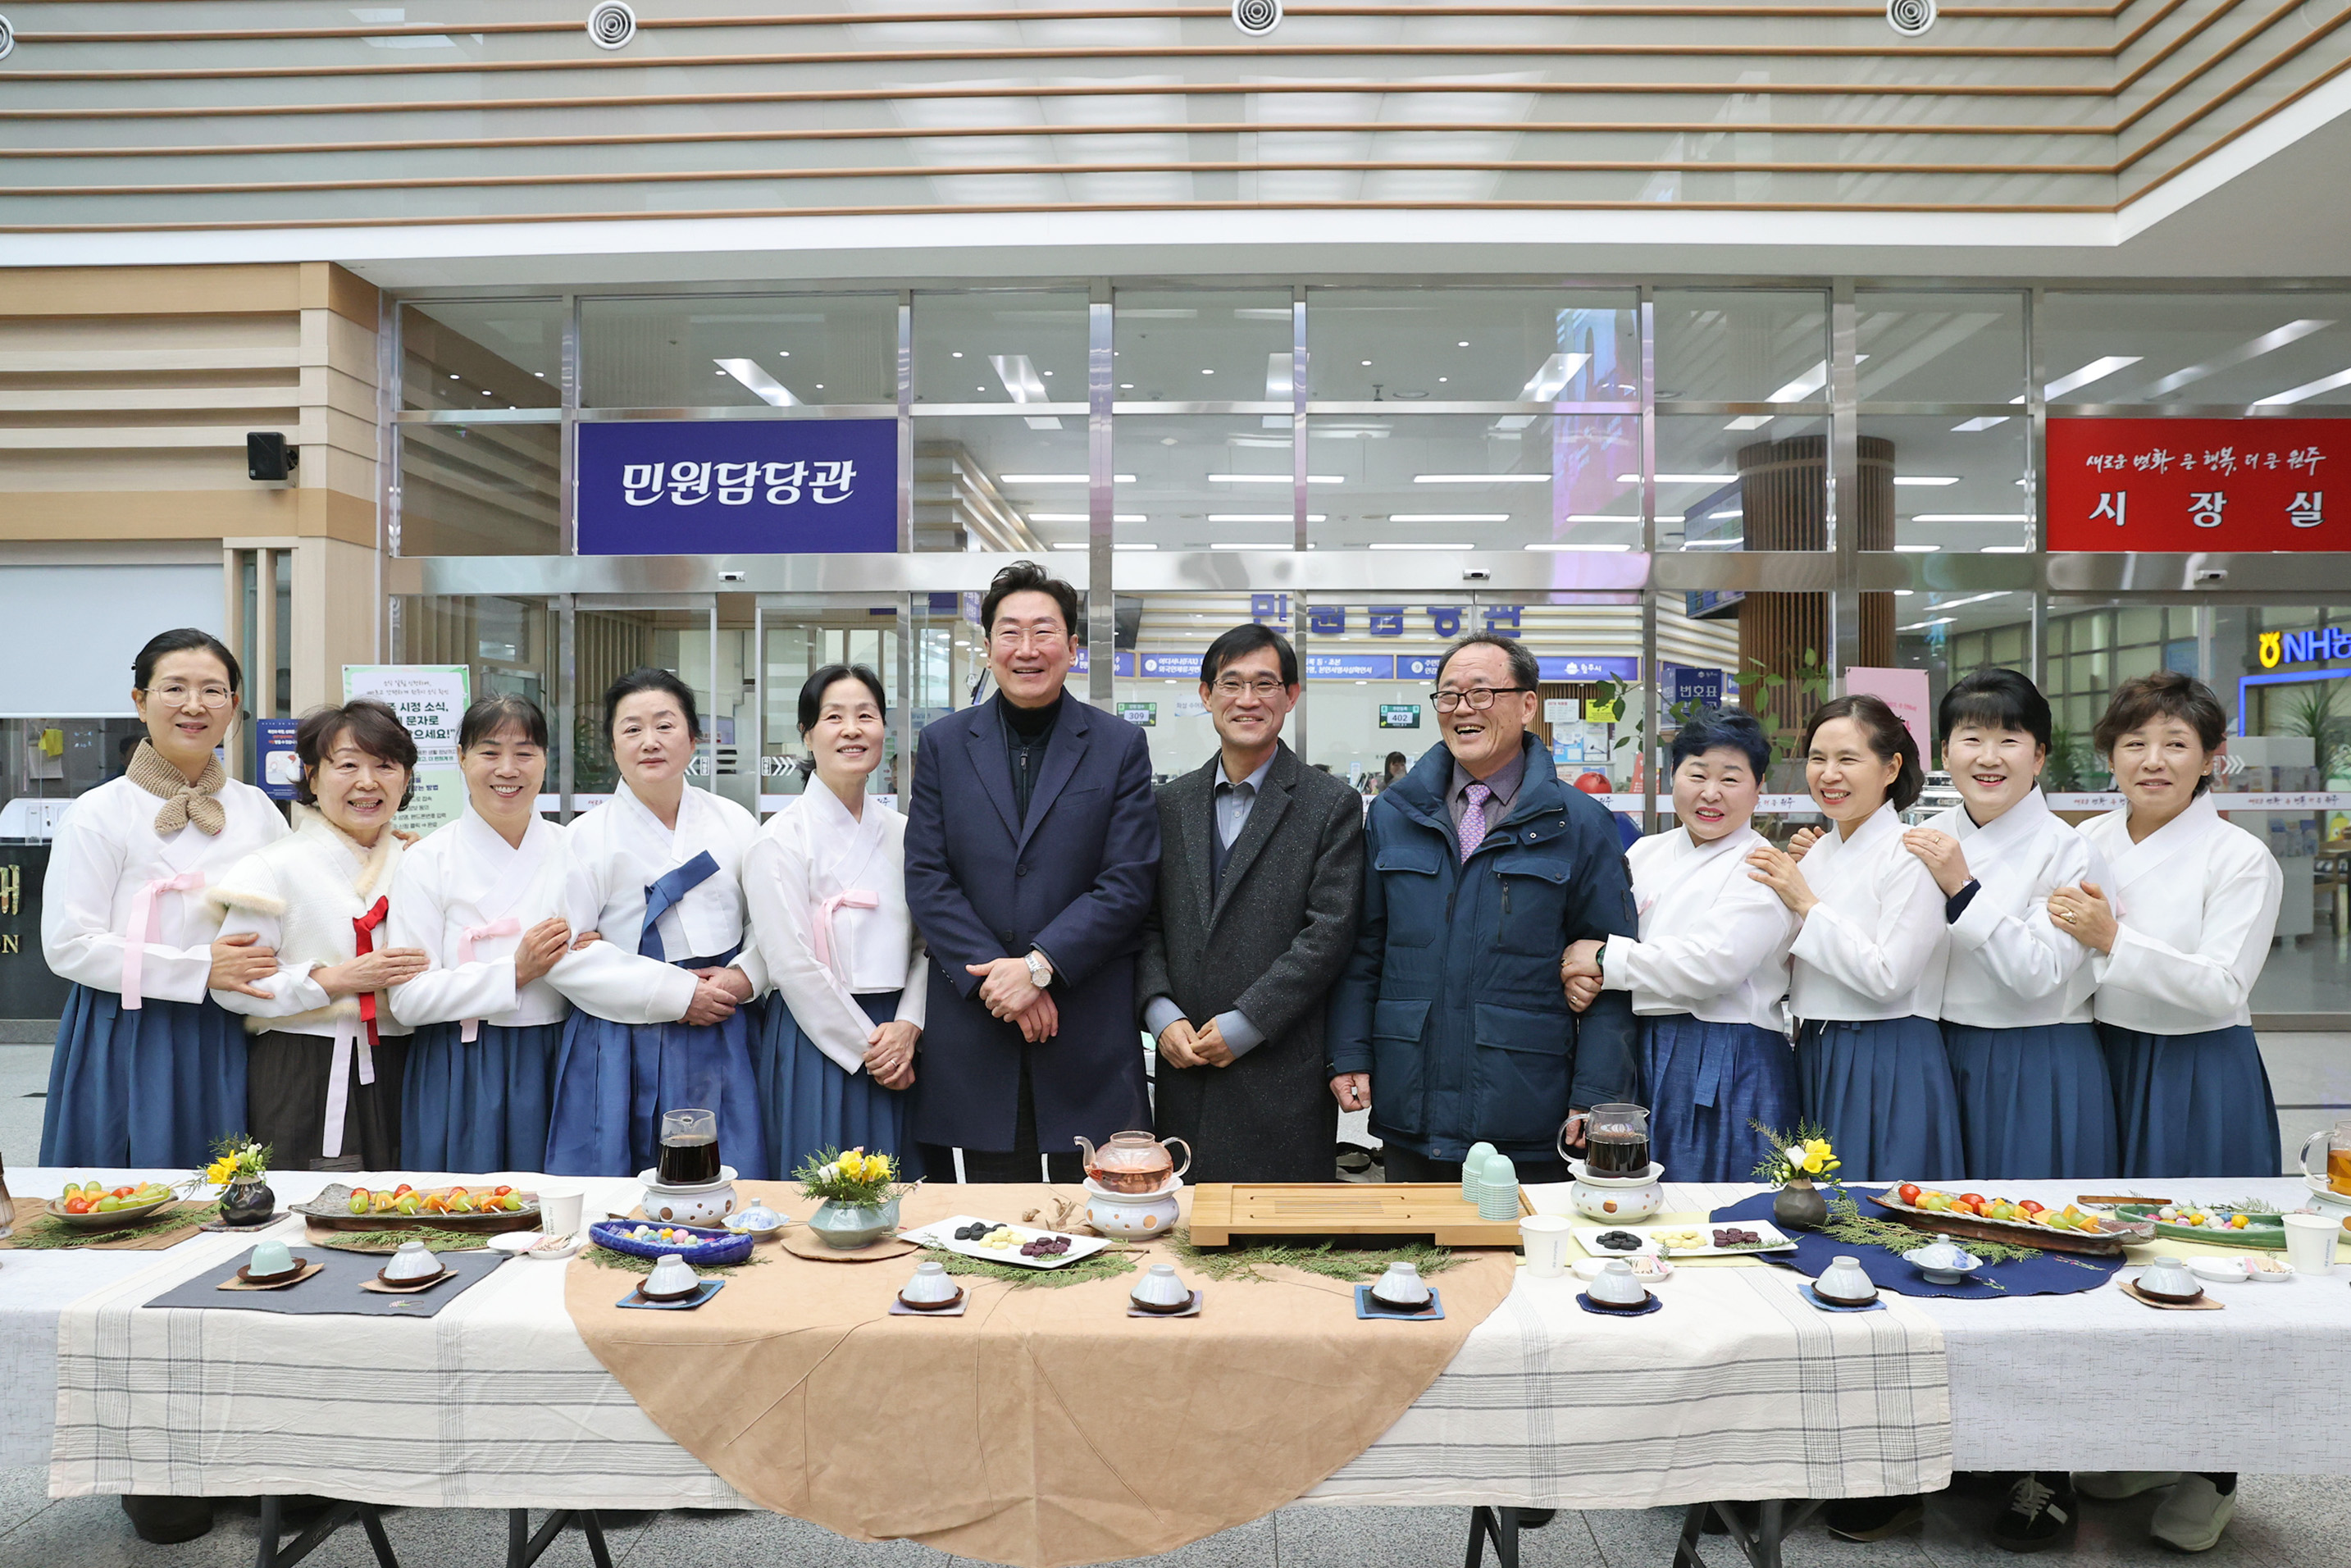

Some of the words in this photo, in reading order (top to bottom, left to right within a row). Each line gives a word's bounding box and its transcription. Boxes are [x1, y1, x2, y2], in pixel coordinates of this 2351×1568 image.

[2086, 454, 2127, 473] 새로운
[2180, 453, 2197, 470] 큰
[2244, 453, 2259, 469] 더
[2263, 453, 2280, 470] 큰
[2287, 447, 2326, 476] 원주
[622, 459, 857, 506] 민원담당관
[1679, 685, 1718, 698] 번호표
[400, 702, 421, 712] 시정
[406, 716, 439, 726] 문자로
